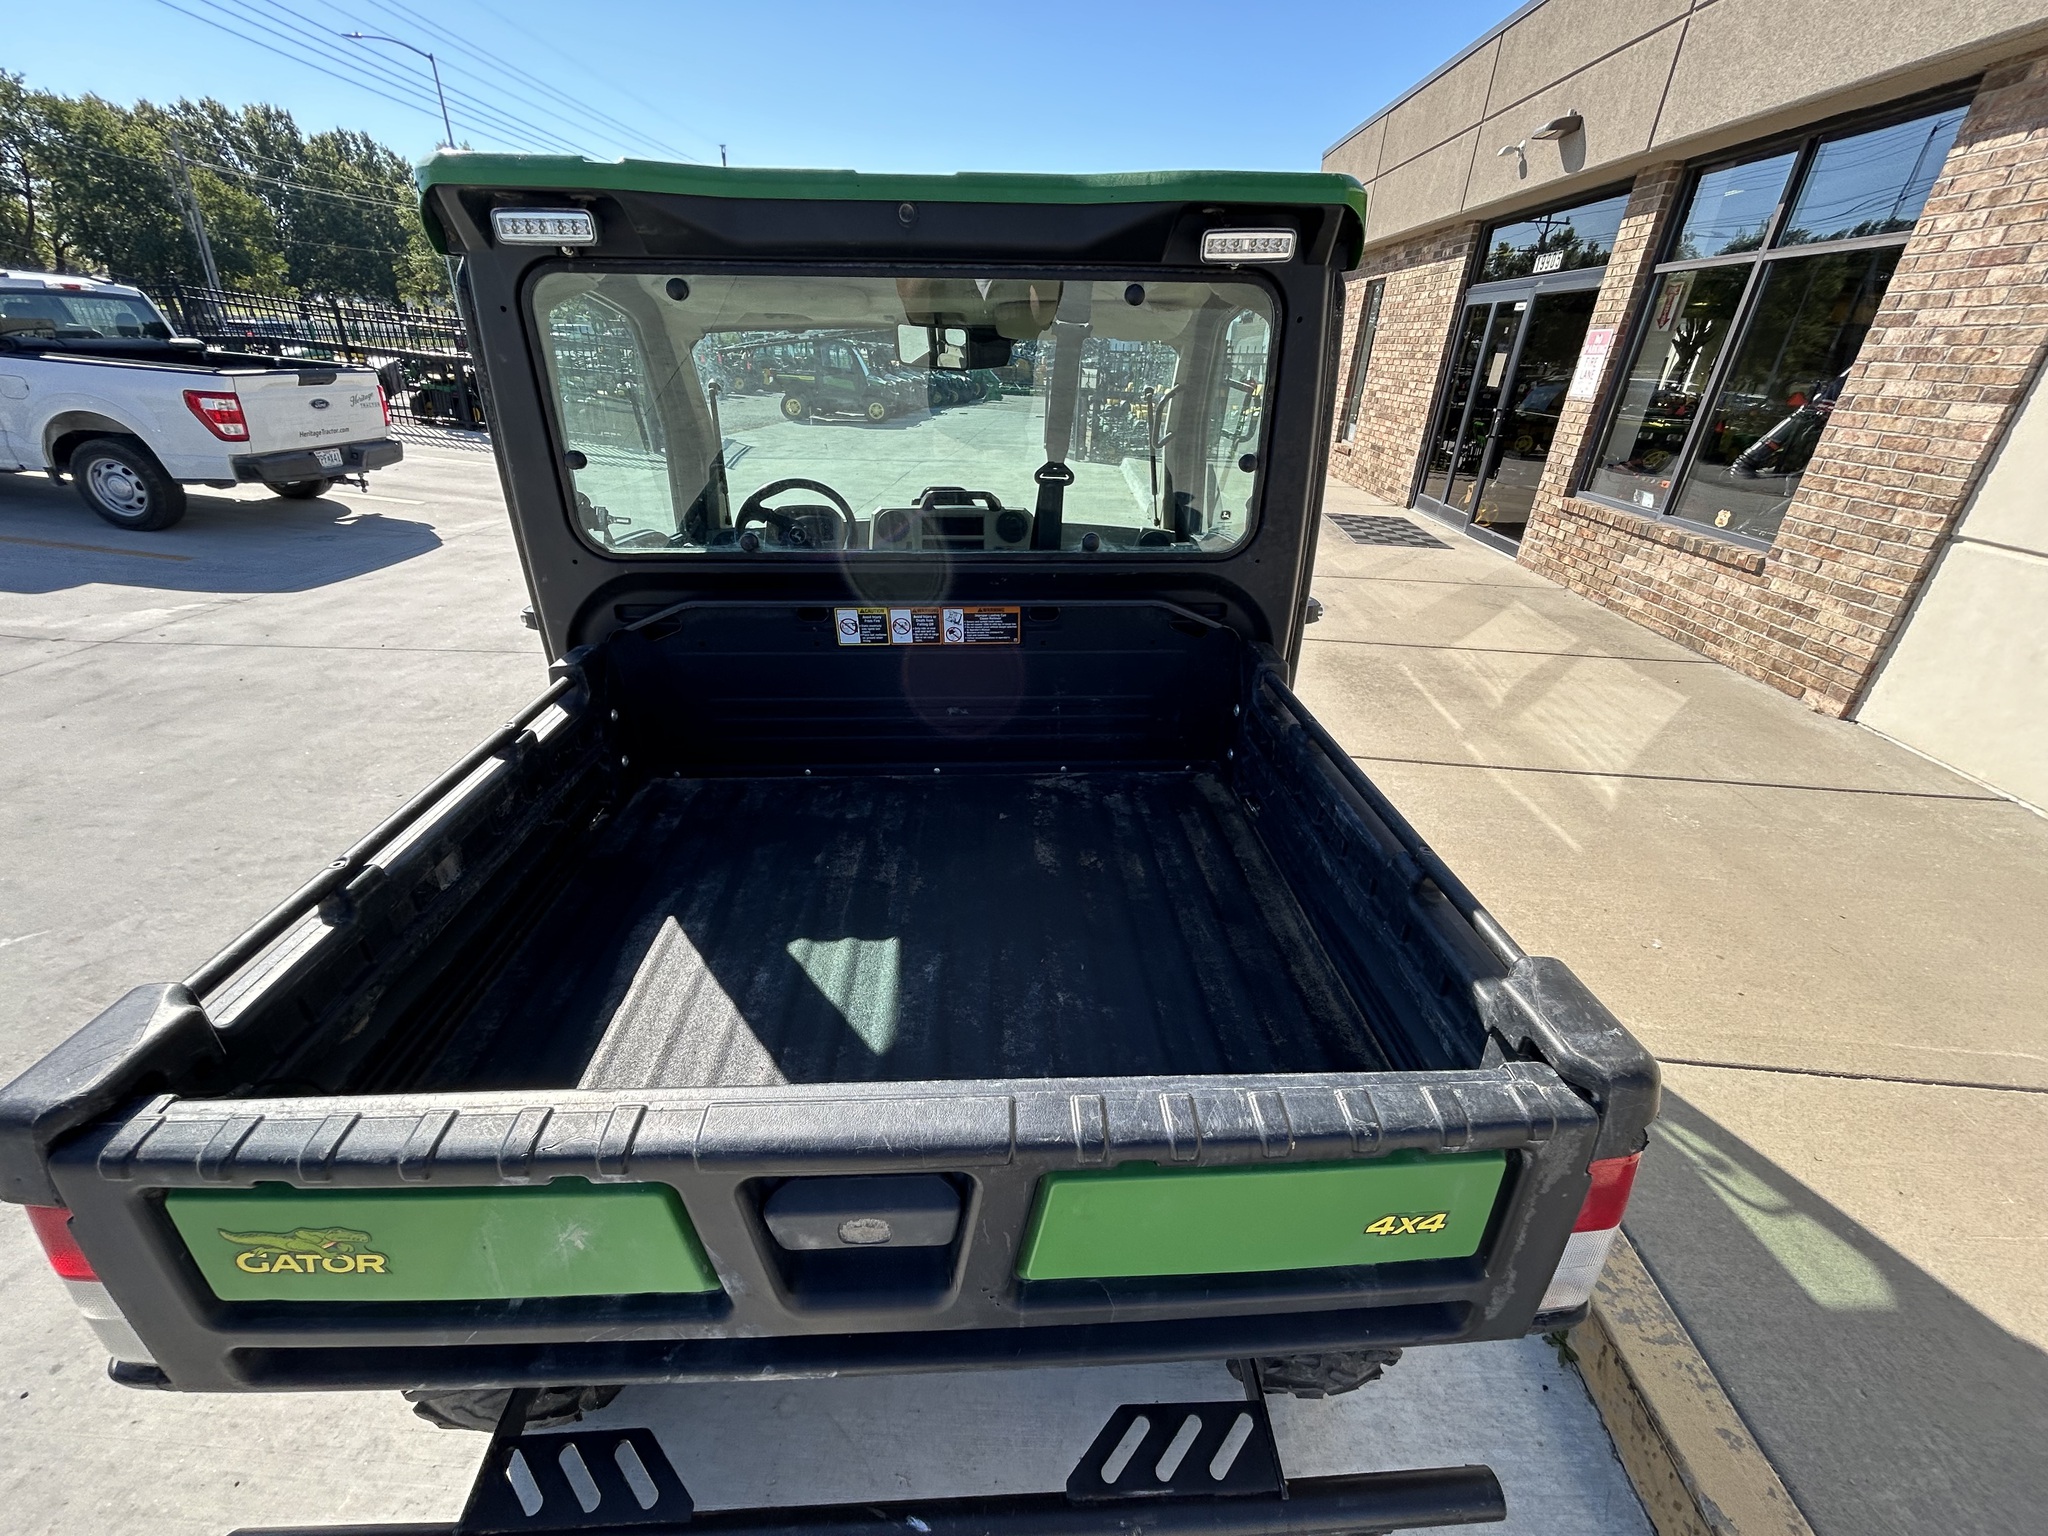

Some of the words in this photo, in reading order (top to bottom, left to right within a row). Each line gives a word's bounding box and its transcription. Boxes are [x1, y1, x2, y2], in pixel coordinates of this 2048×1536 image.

[1536, 251, 1563, 271] 19905
[1579, 369, 1596, 380] LANE
[299, 427, 350, 438] HeritageTractor.com
[235, 1251, 387, 1274] GATOR
